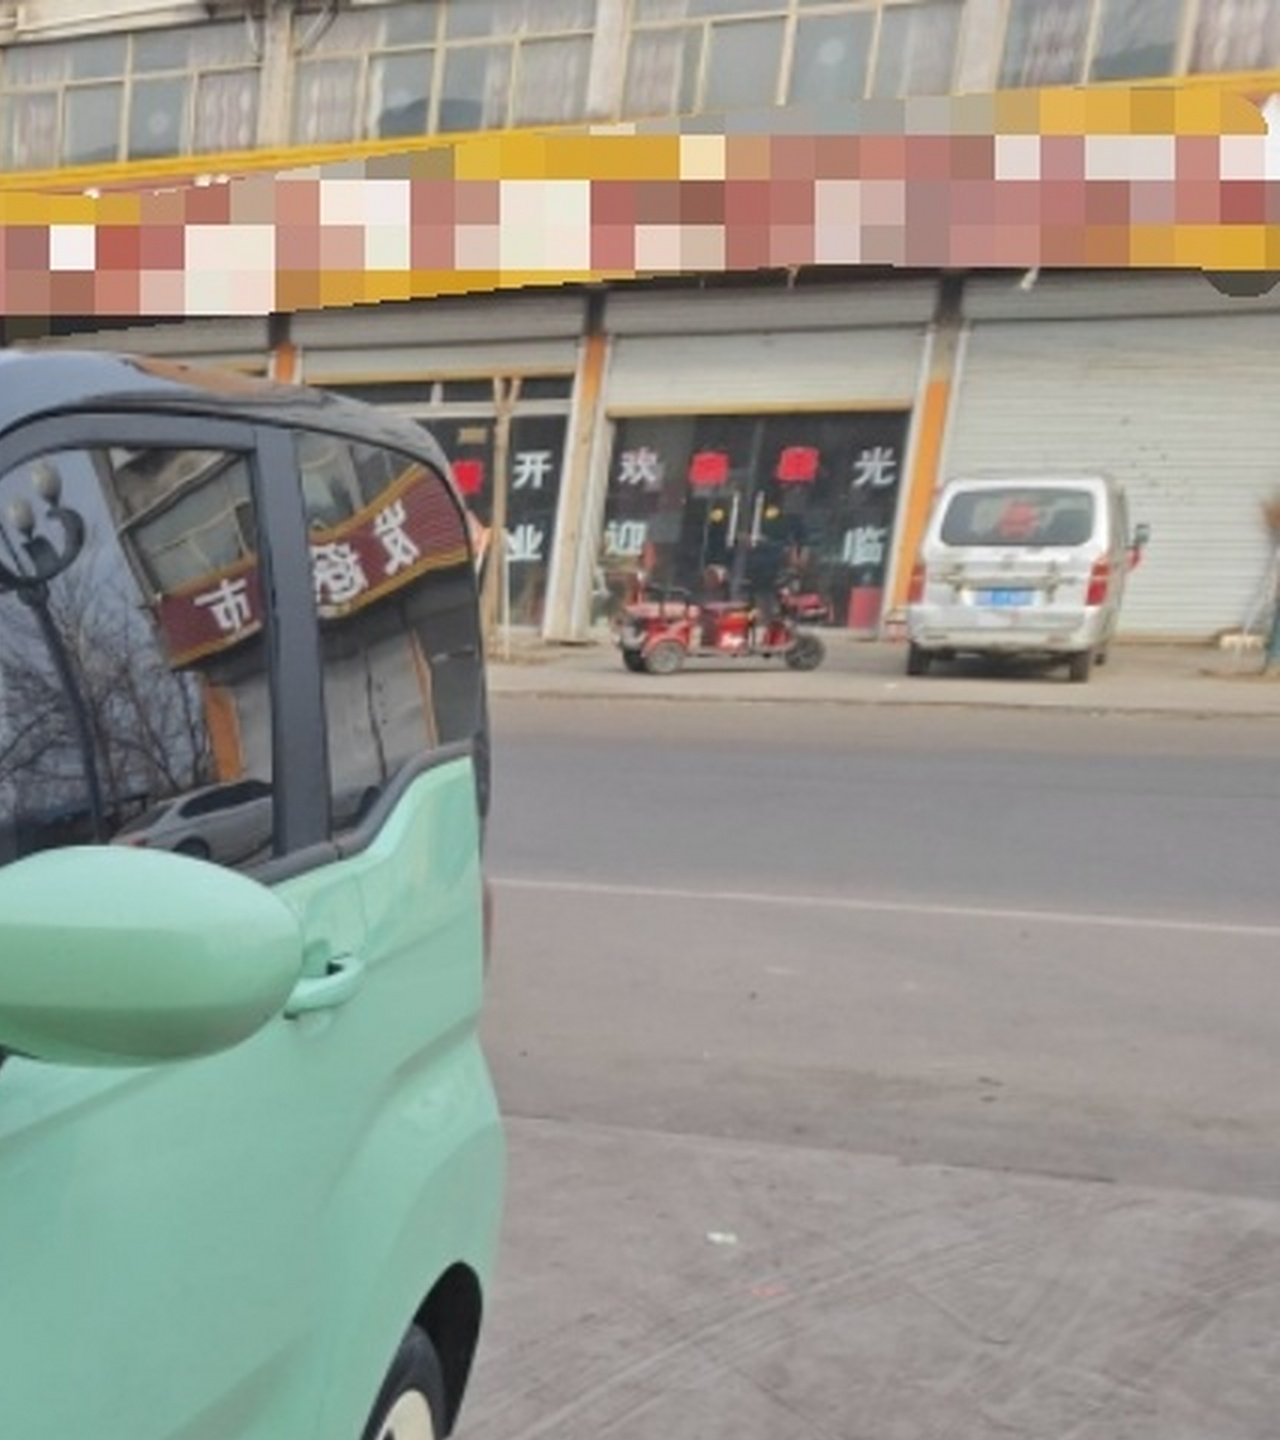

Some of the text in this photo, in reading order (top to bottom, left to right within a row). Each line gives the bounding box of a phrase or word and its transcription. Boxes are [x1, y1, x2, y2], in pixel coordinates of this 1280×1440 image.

[506, 451, 553, 562] 开业
[604, 448, 658, 557] 欢迎
[842, 446, 897, 566] 光临
